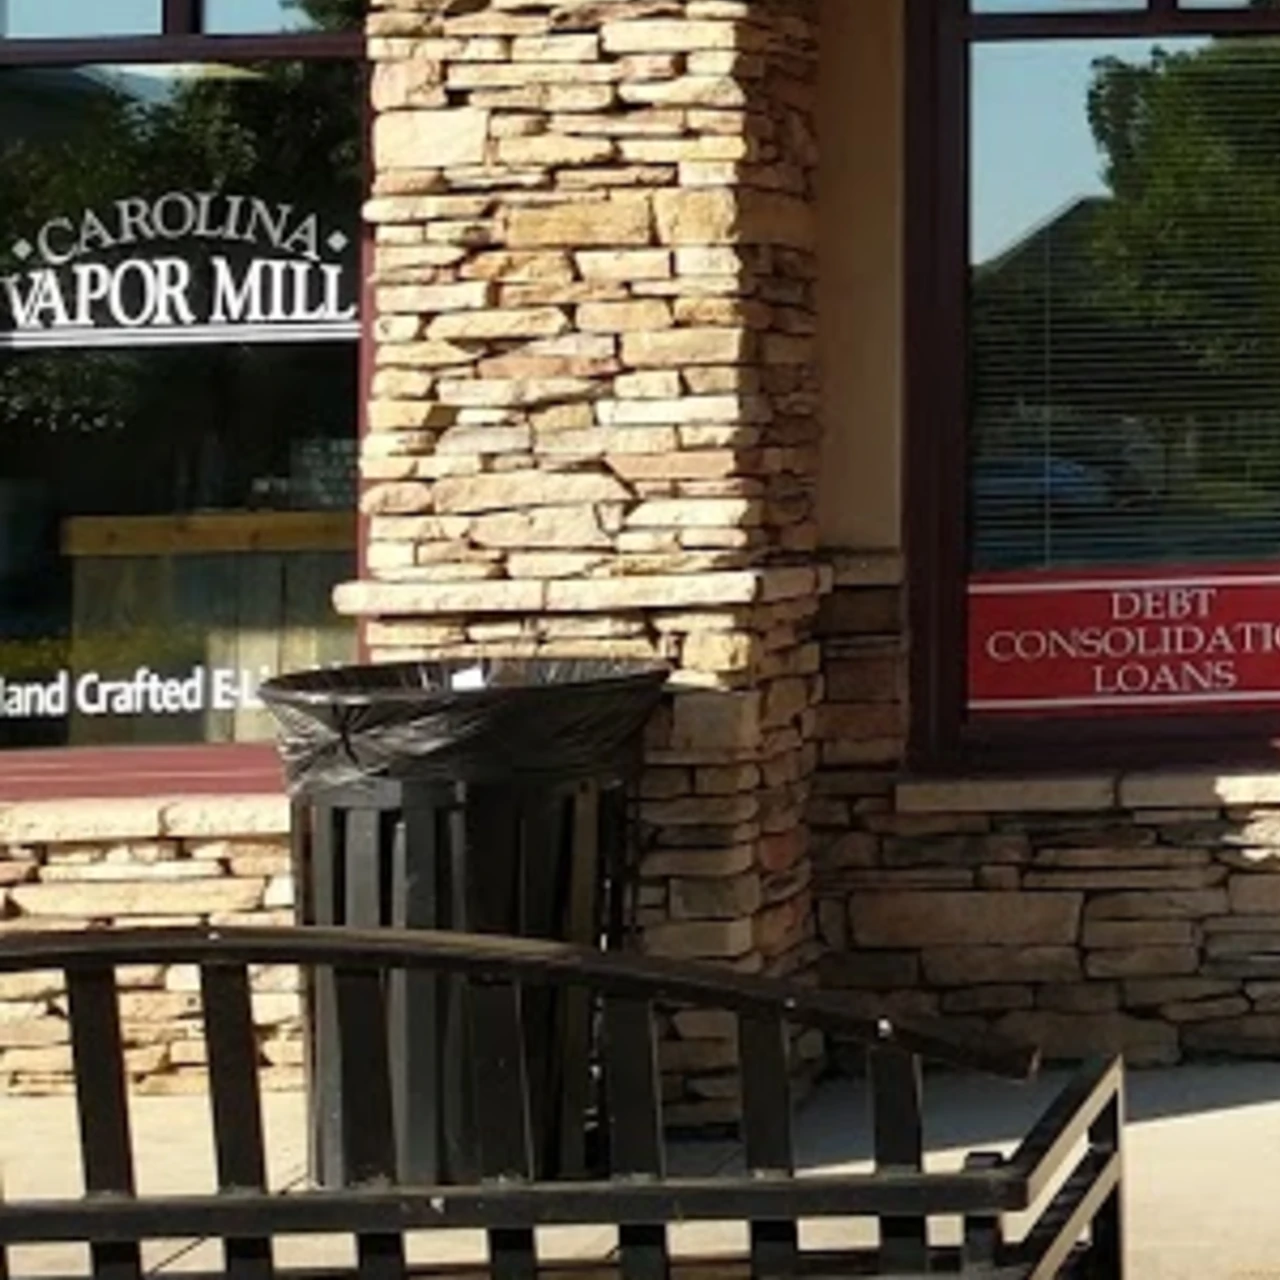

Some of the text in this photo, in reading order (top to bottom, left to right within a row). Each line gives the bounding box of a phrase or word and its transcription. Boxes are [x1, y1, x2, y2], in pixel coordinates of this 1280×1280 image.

[36, 191, 322, 264] CAROLINA
[0, 255, 357, 329] VAPOR MILL
[1110, 587, 1218, 620] DEBT
[0, 668, 69, 717] and
[75, 665, 205, 714] Crafted
[1092, 659, 1238, 693] LOANS
